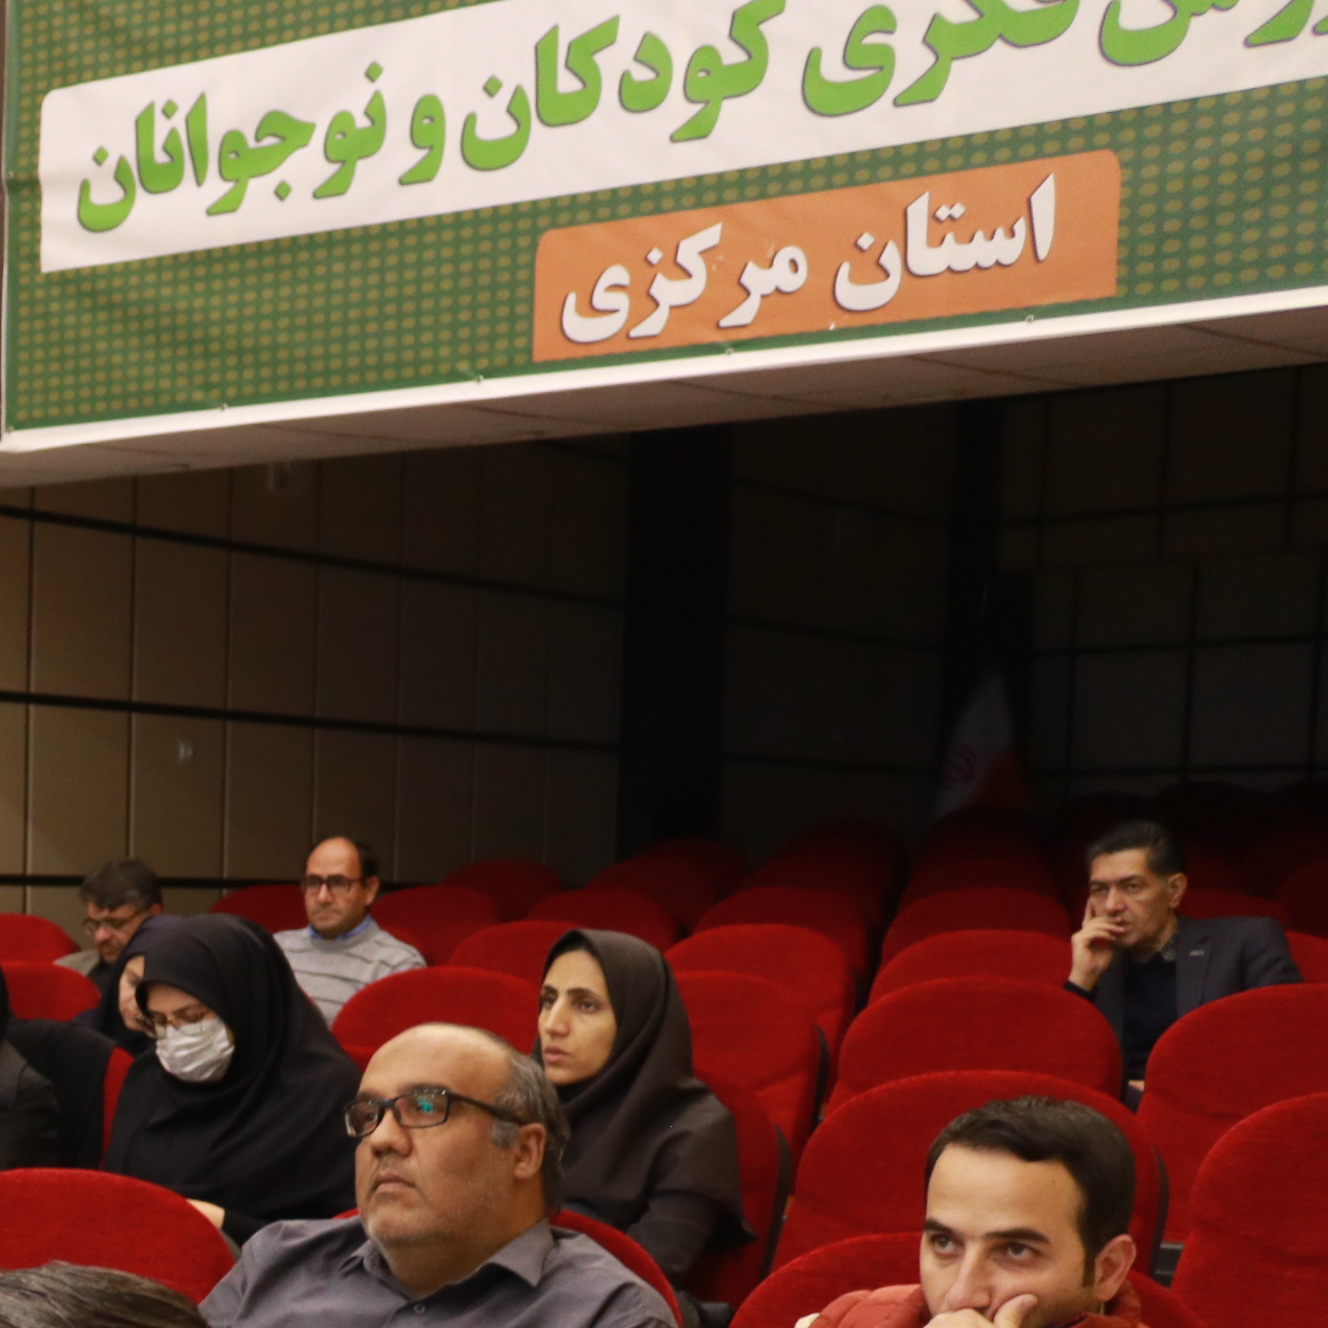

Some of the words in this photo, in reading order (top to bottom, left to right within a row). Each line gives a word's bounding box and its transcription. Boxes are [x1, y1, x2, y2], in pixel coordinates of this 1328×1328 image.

[76, 60, 387, 233] نوجوانان
[398, 93, 446, 186] و
[460, 0, 788, 172] کودکان
[560, 221, 809, 344] مرکزی
[833, 172, 1056, 312] استان
